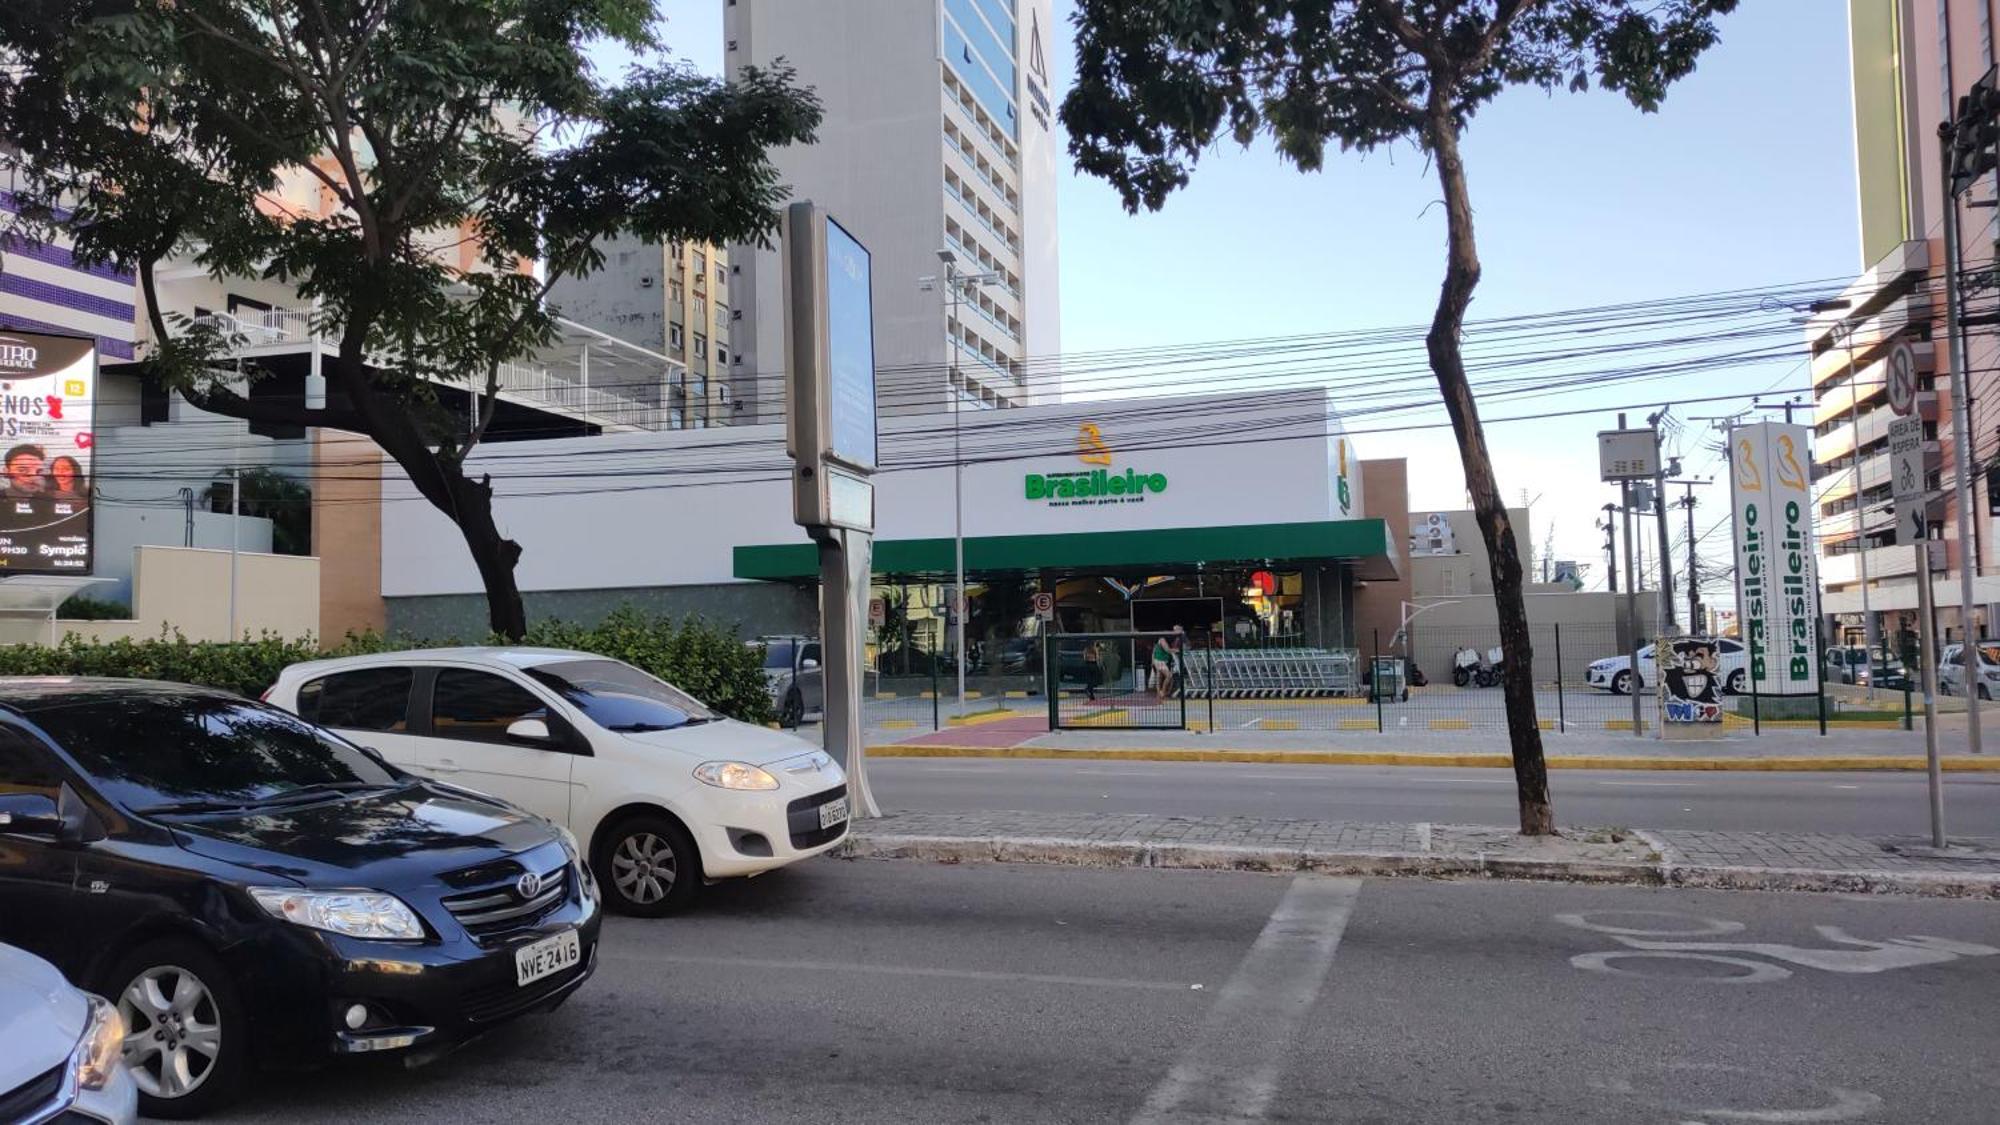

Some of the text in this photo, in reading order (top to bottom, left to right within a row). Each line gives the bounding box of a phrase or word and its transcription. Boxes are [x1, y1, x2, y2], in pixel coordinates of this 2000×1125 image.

[1893, 437, 1920, 455] ESPERA
[1025, 468, 1168, 499] Brasileiro
[1040, 597, 1049, 607] E
[1743, 503, 1766, 681] Brasileiro
[1781, 500, 1809, 681] Brasileiro
